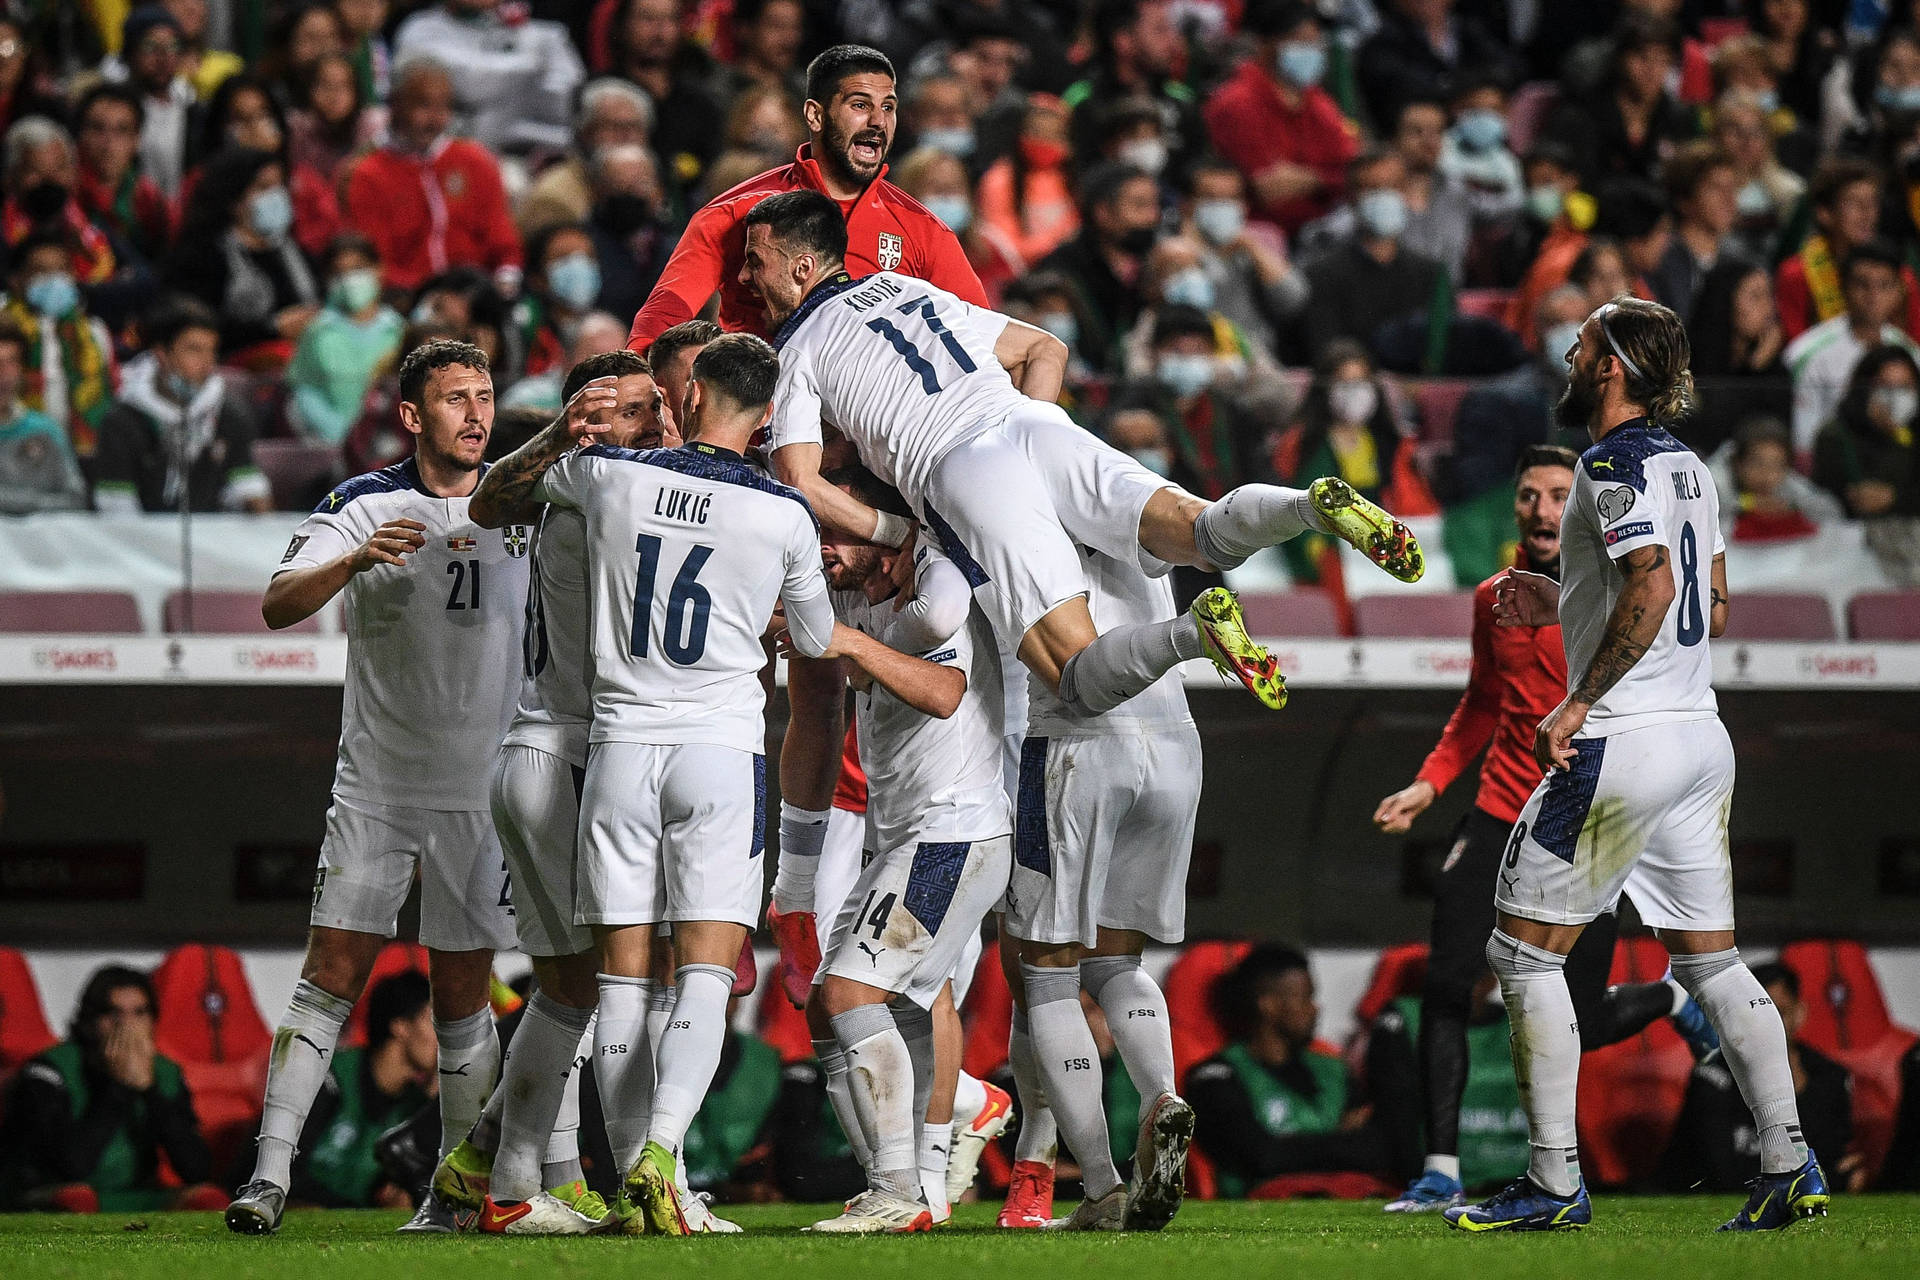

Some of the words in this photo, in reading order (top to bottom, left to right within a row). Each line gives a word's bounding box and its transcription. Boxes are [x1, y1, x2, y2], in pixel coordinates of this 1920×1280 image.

[843, 276, 902, 312] KOSTIĆ
[865, 294, 978, 396] 17
[654, 487, 713, 525] LUKIĆ
[1617, 524, 1653, 537] RESPECT
[446, 560, 480, 610] 21
[631, 533, 715, 666] 16
[1677, 520, 1704, 647] 8
[928, 651, 956, 662] SPECT
[1506, 820, 1527, 869] 8
[852, 889, 897, 940] 14
[665, 1021, 691, 1031] FSS
[1127, 1009, 1156, 1019] FSS
[601, 1044, 627, 1056] FSS
[1064, 1058, 1090, 1072] FSS
